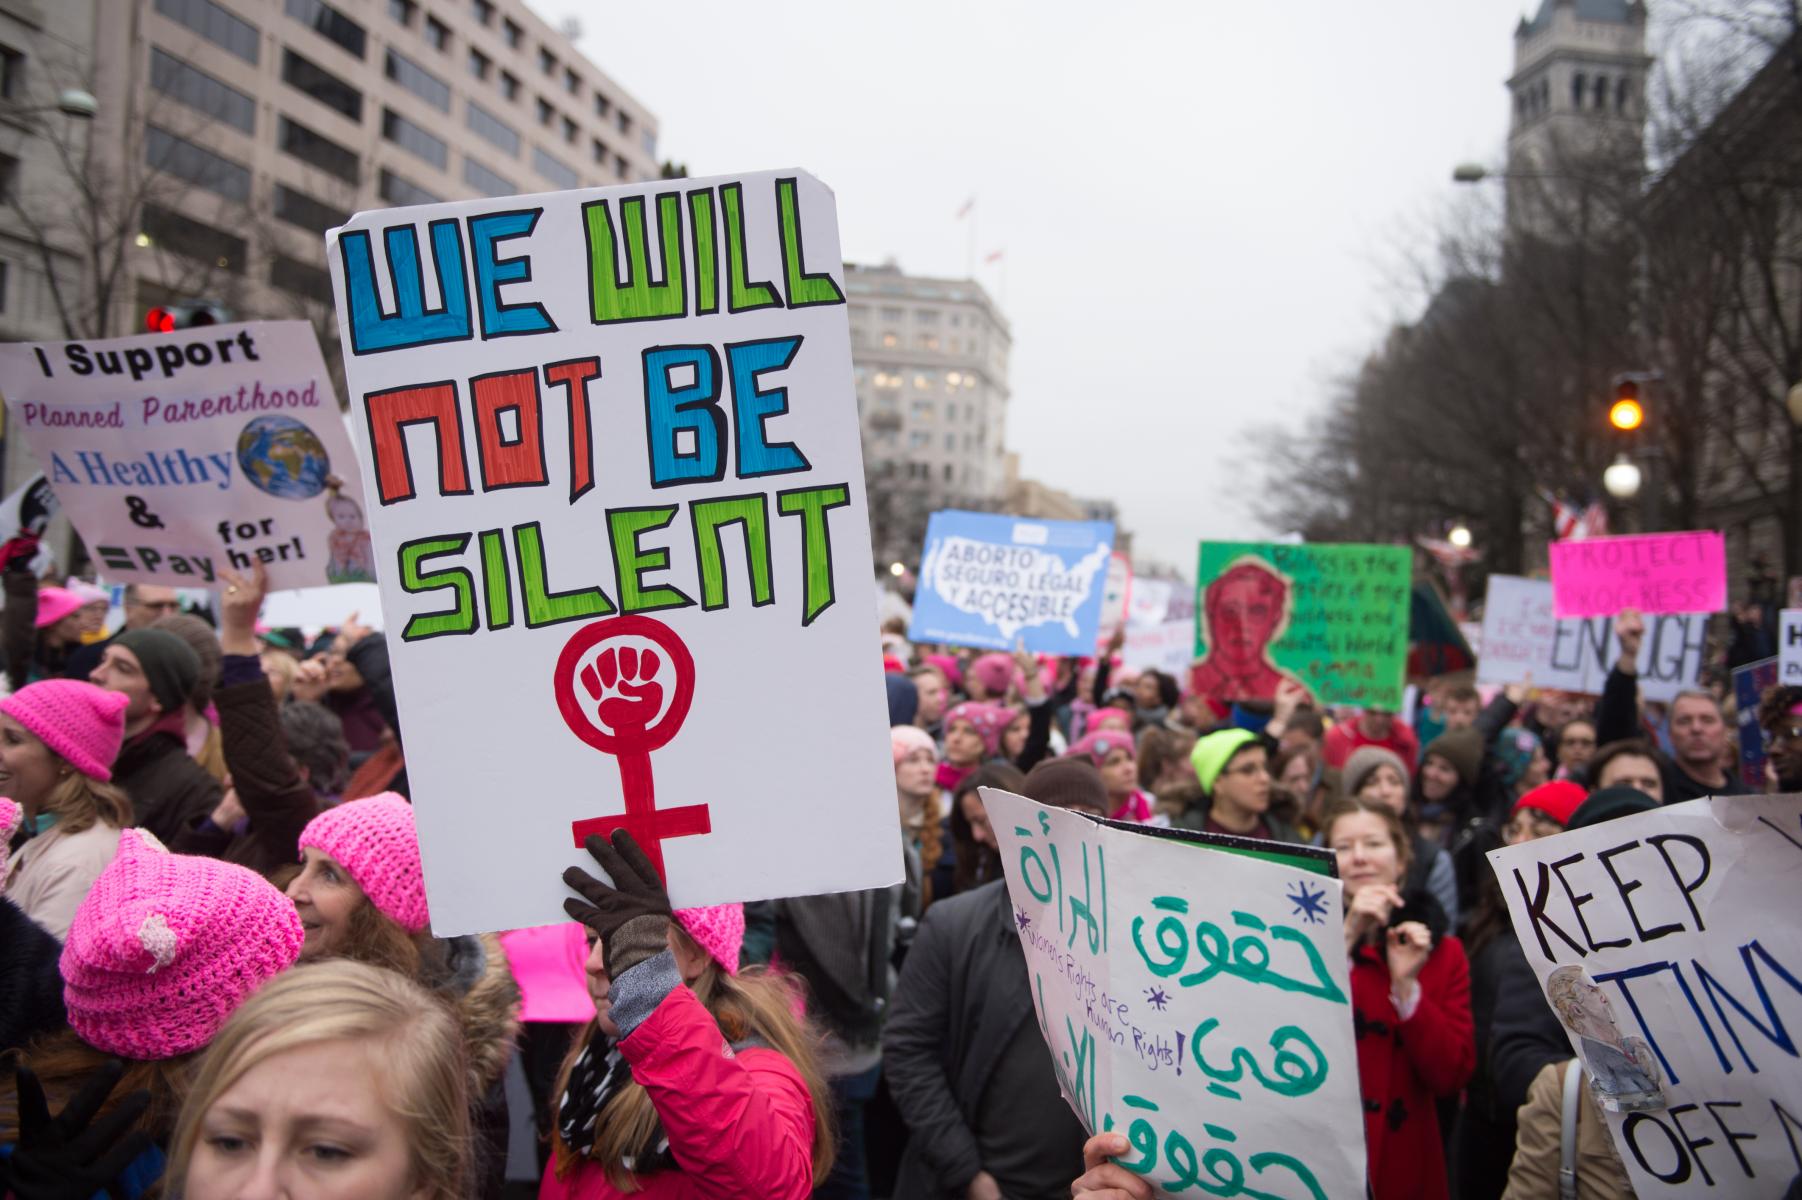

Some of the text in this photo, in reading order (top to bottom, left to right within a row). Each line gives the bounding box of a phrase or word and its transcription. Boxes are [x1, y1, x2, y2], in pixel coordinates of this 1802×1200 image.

[338, 177, 847, 356] WE WILL
[33, 330, 260, 382] I Support
[23, 380, 321, 430] Planned Parenthood
[363, 335, 813, 506] NOT BE
[51, 448, 233, 490] A Healthy
[124, 494, 166, 531] &
[217, 517, 275, 545] for
[226, 536, 306, 571] her!
[397, 483, 851, 642] SILENT
[947, 544, 1034, 570] ABORTO
[1559, 534, 1709, 569] PROTECT
[965, 589, 1074, 622] ACCESIBLE
[1027, 573, 1084, 594] LEGAL
[1513, 833, 1711, 964] KEEP
[1132, 896, 1349, 1006] حقوق
[1066, 953, 1097, 1002] Rights
[1101, 992, 1130, 1027] are
[1132, 1026, 1186, 1077] Rights!
[1192, 1017, 1329, 1100] هي
[1622, 1100, 1758, 1187] OFF
